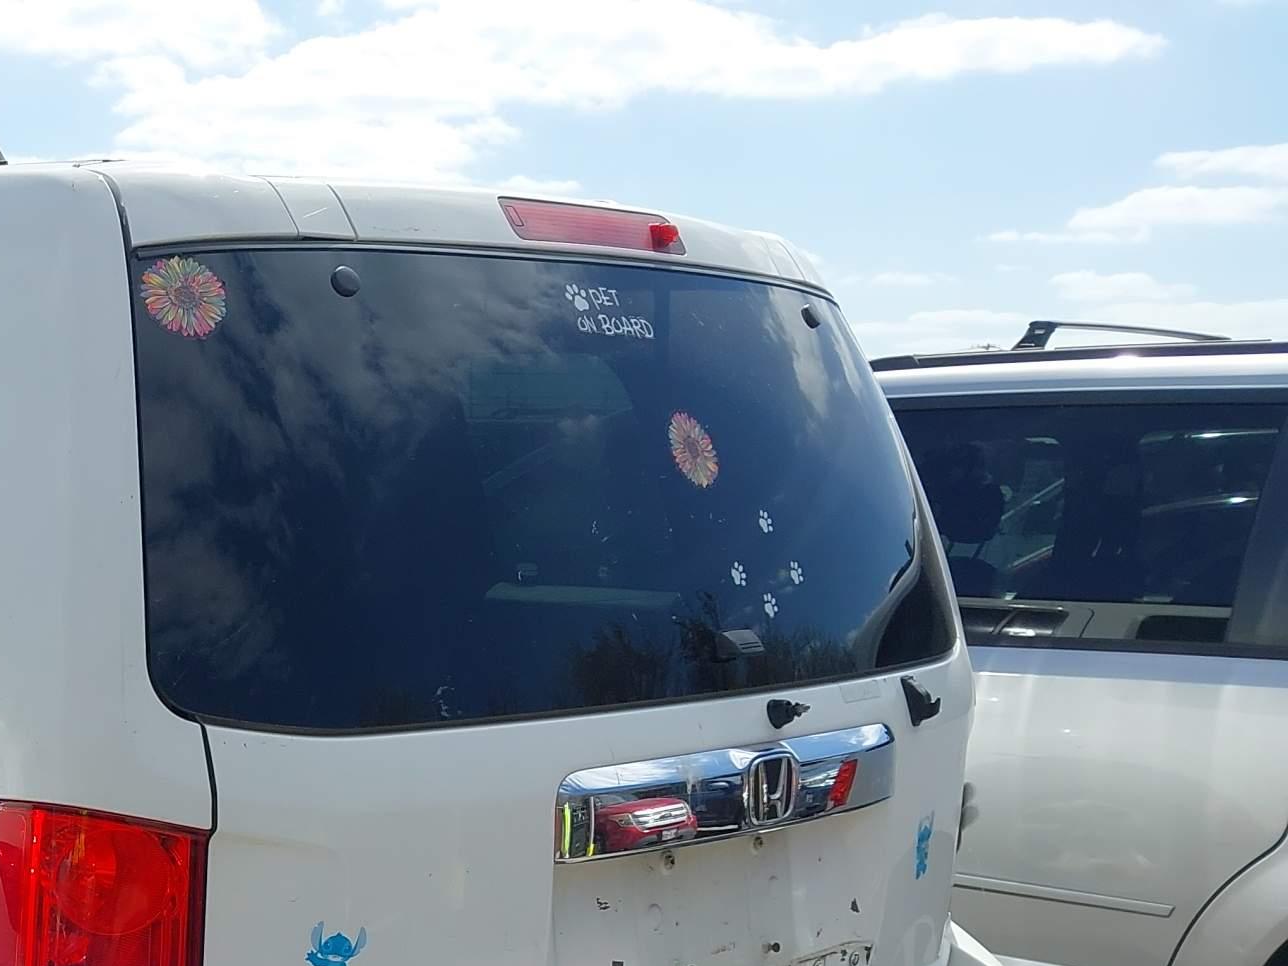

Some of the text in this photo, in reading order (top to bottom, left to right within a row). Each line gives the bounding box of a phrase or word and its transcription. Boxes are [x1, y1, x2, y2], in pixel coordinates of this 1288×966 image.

[588, 287, 620, 310] PET
[577, 314, 656, 339] ON BOARD
